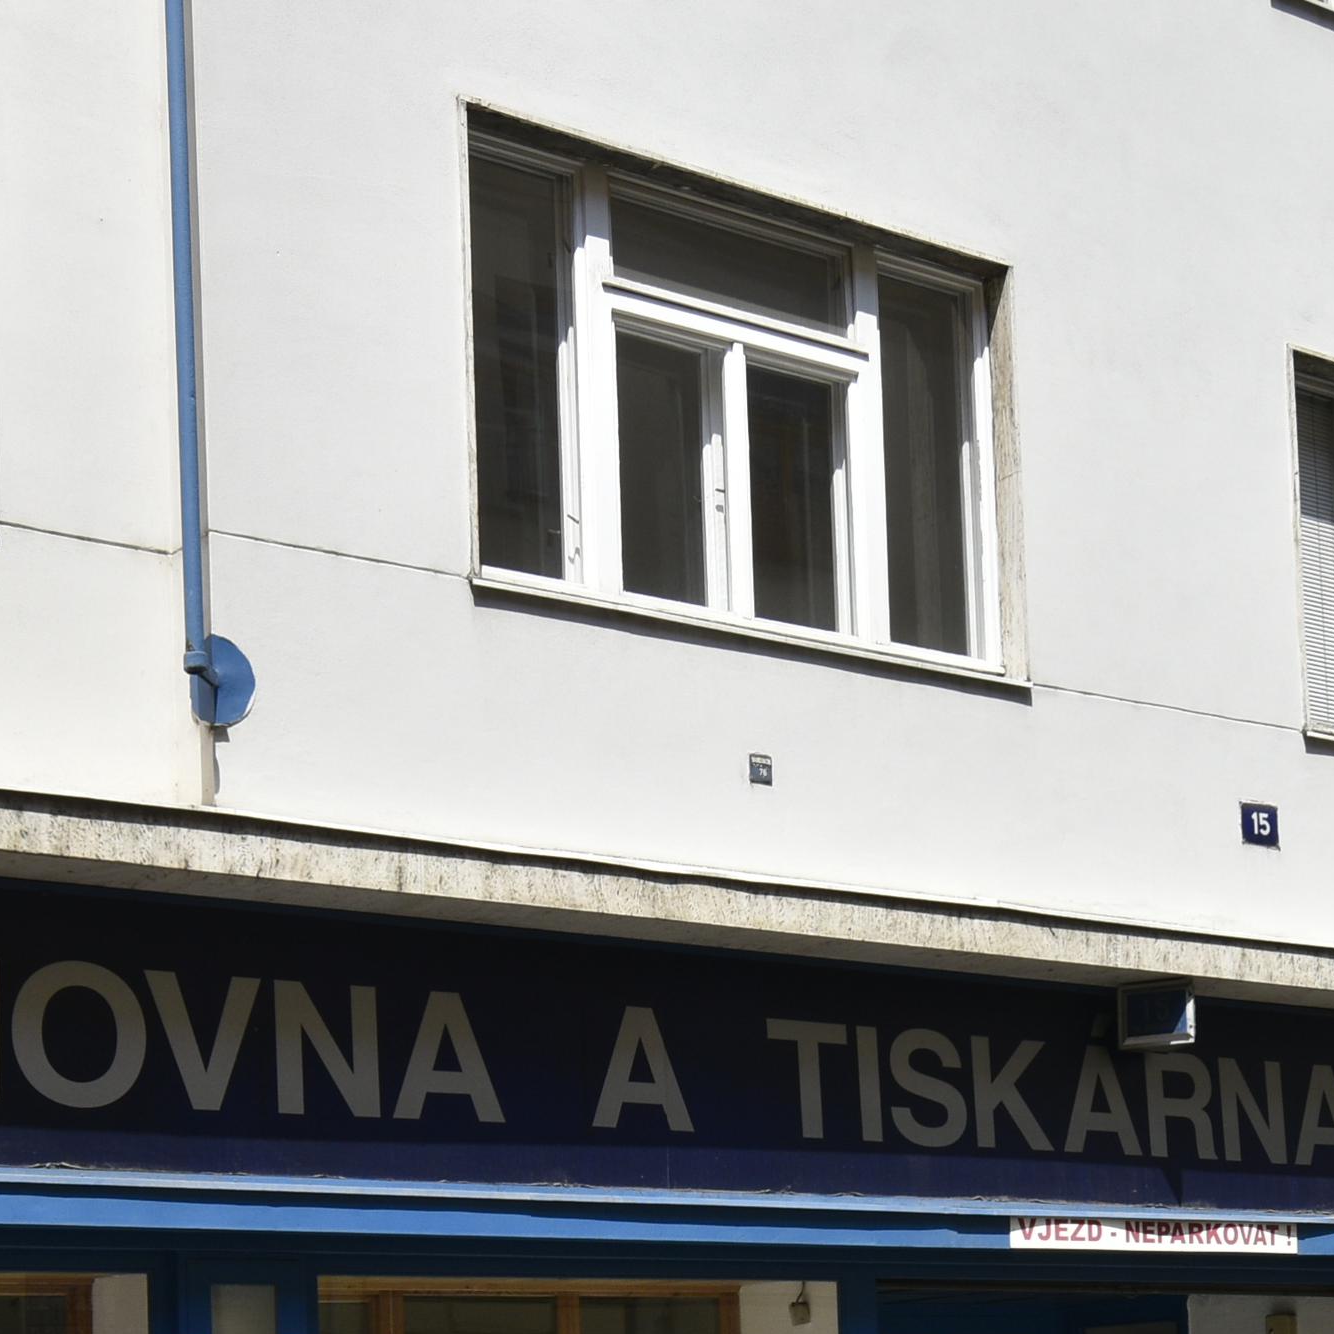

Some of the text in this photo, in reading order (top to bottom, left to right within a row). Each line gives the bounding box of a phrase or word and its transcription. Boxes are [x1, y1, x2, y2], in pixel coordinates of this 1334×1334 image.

[1251, 811, 1271, 836] 15
[592, 1005, 695, 1132] A
[1019, 1217, 1103, 1242] VJEZD
